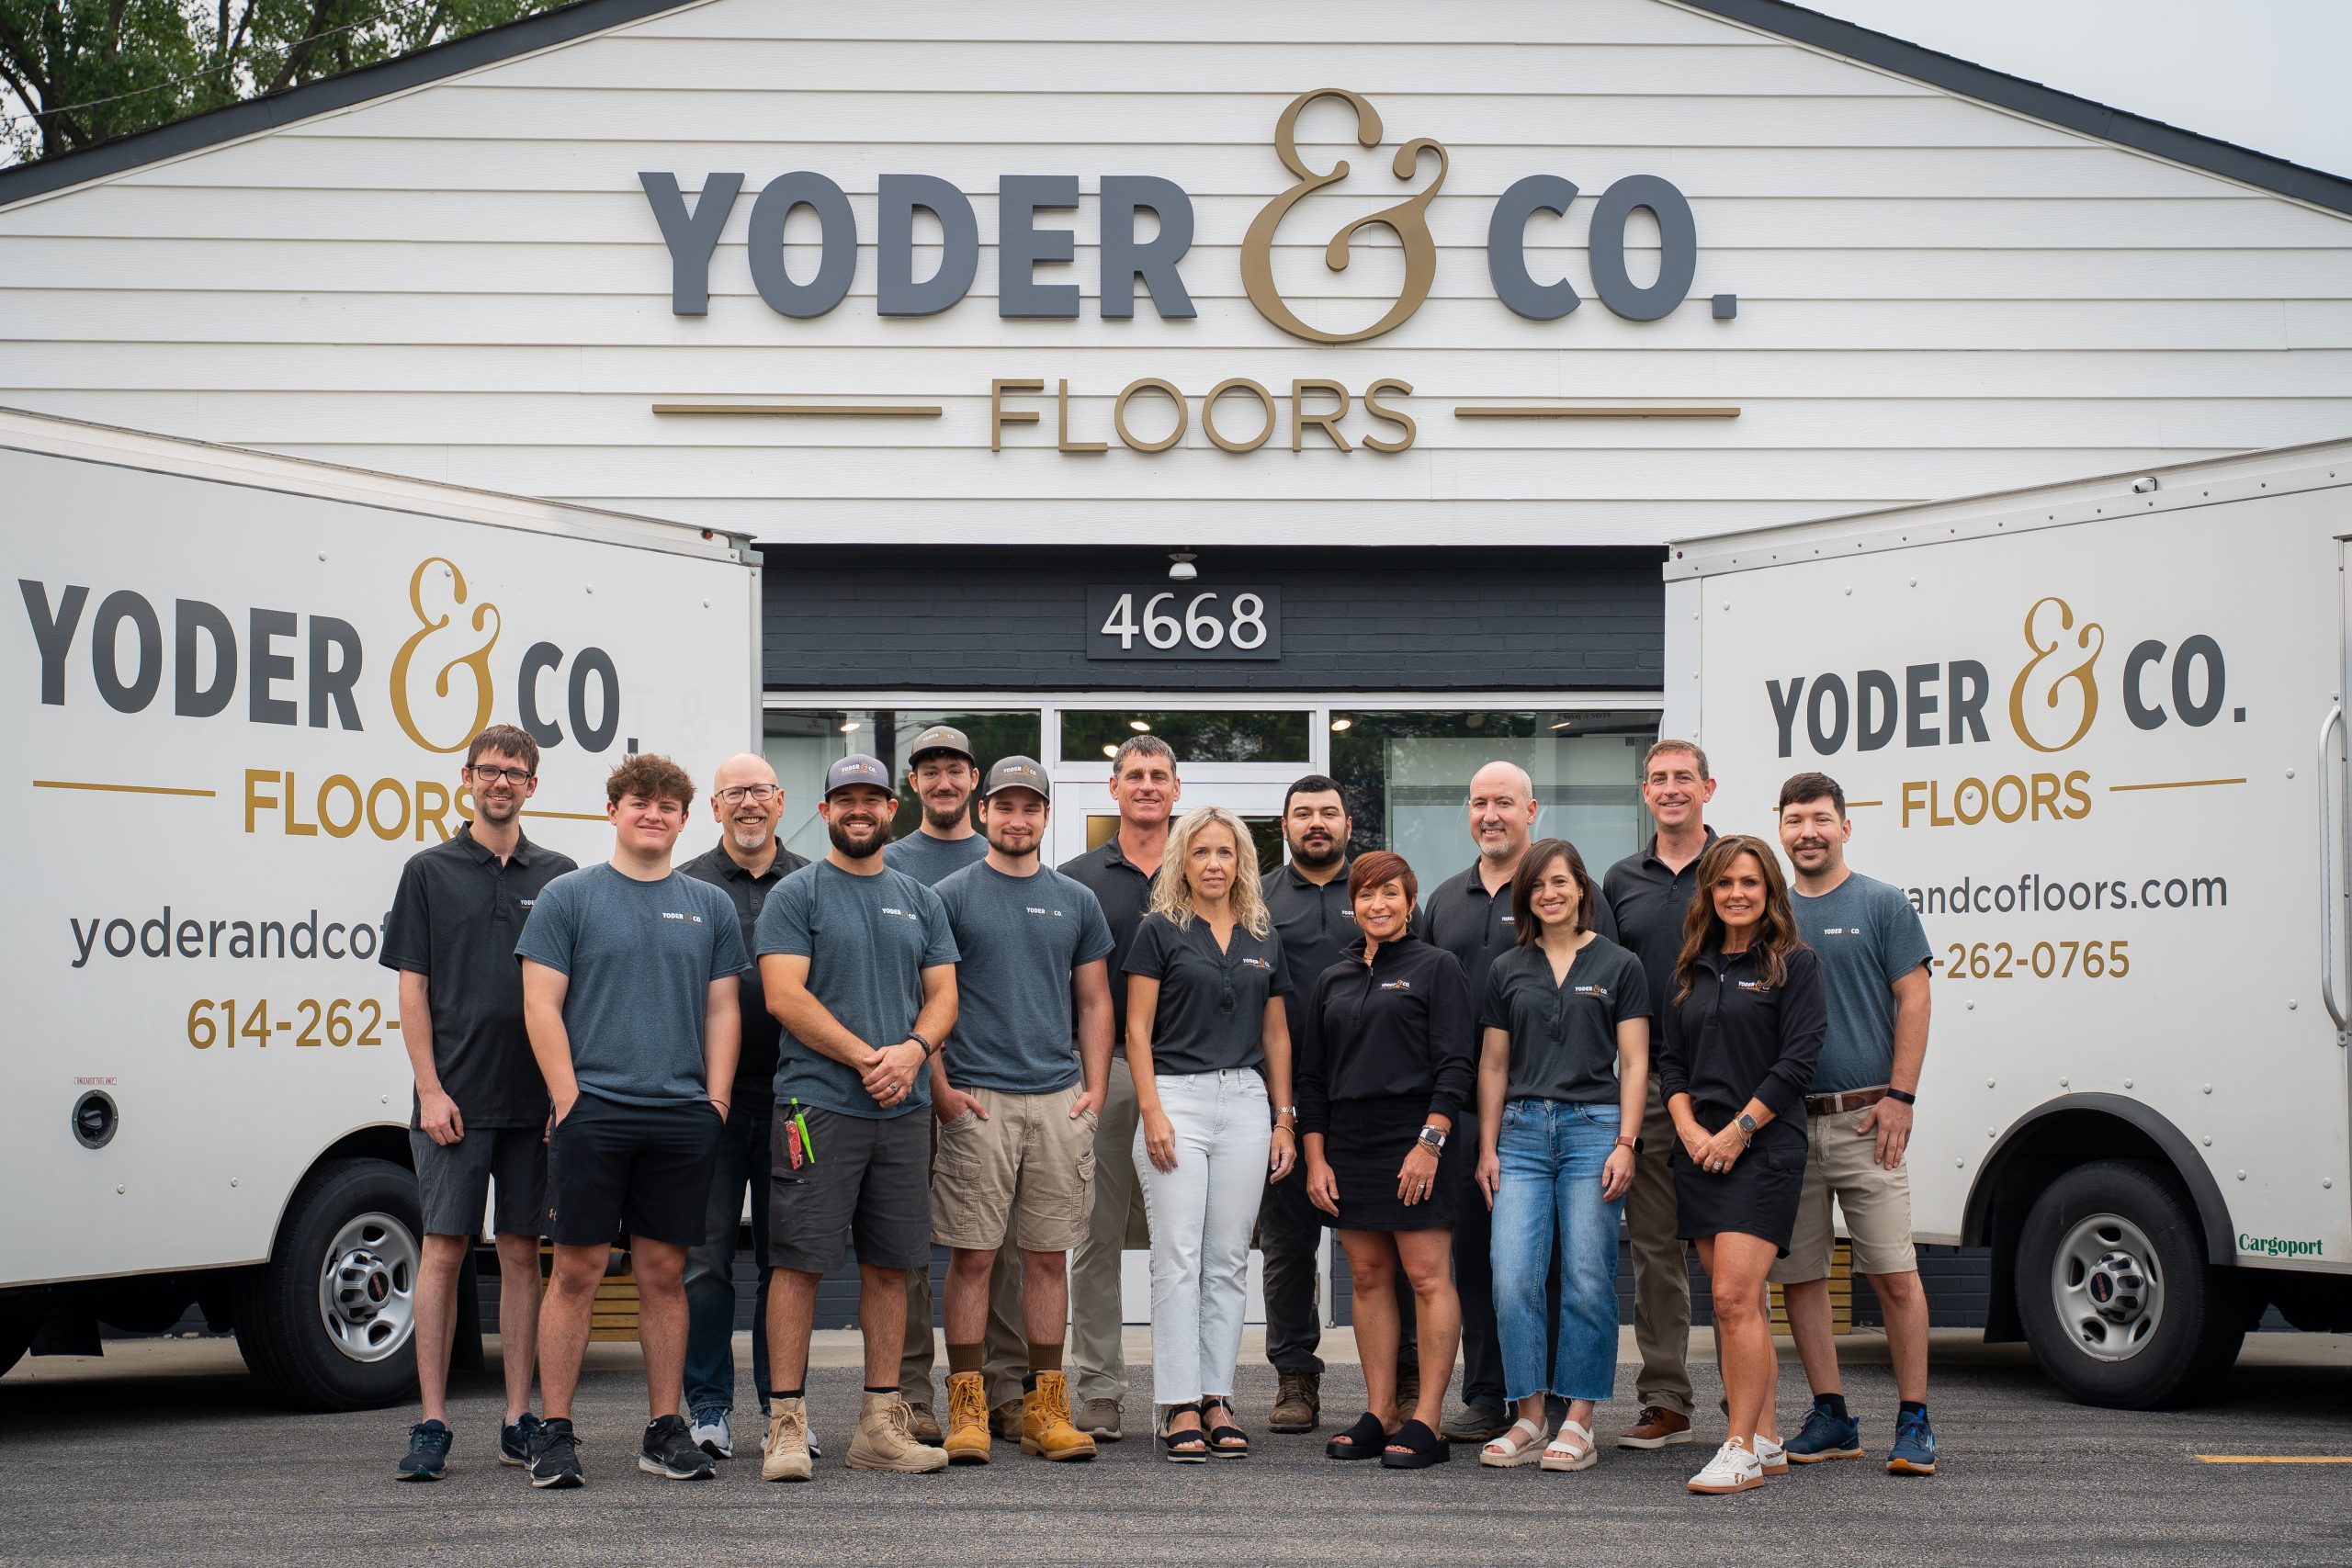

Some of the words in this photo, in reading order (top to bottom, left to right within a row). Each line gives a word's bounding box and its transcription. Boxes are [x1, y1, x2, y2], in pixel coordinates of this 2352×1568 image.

[638, 171, 1198, 320] YODER
[1240, 87, 1449, 344] &
[1487, 174, 1736, 321] CO.
[991, 378, 1417, 454] FLOORS
[1101, 592, 1267, 649] 4668
[17, 578, 364, 732] YODER
[390, 557, 501, 753] &
[517, 641, 639, 753] CO.
[1765, 659, 1991, 758] YODER
[2009, 596, 2105, 752] &
[2122, 634, 2246, 730] CO.
[842, 763, 860, 773] YODER
[1903, 770, 2092, 828] FLOORS
[882, 908, 901, 916] YODER
[1026, 907, 1046, 915] YODER
[1902, 874, 2227, 915] andcofloors.com
[2239, 1233, 2323, 1257] Cargoport
